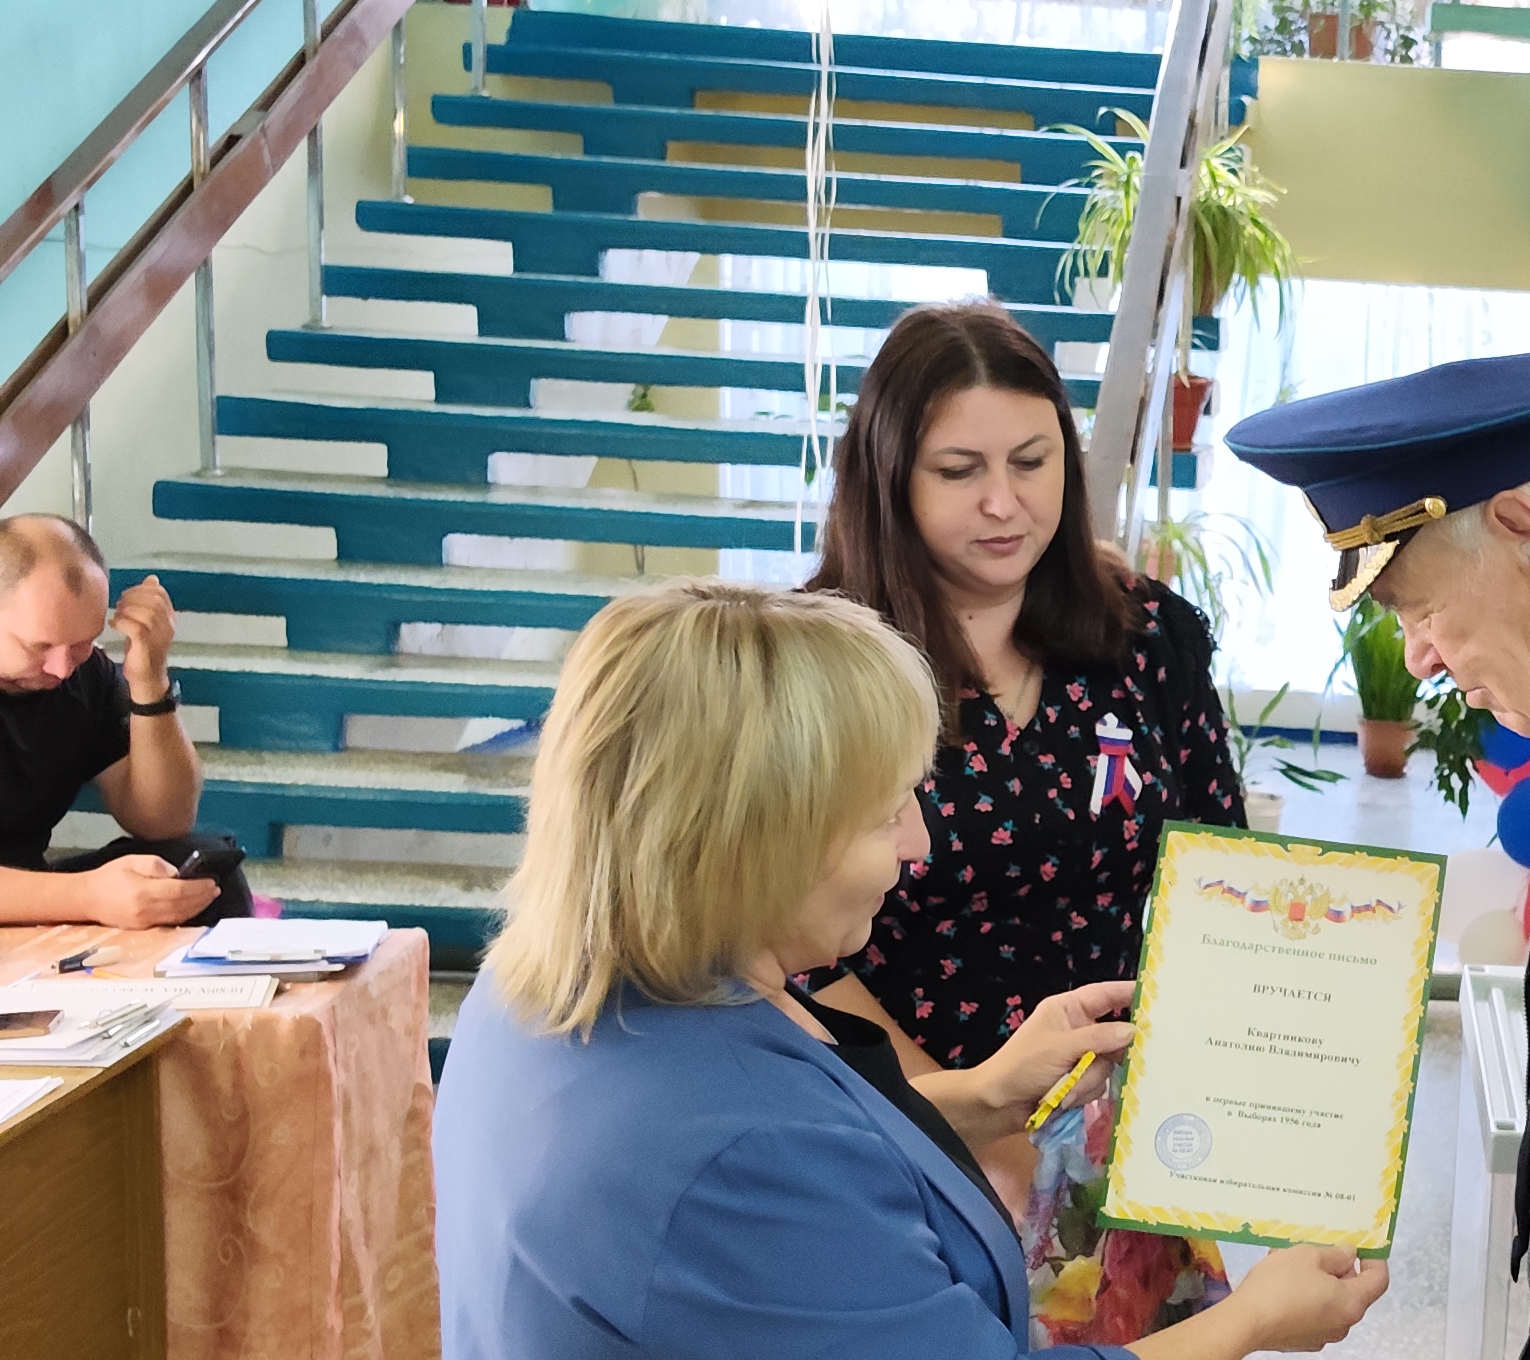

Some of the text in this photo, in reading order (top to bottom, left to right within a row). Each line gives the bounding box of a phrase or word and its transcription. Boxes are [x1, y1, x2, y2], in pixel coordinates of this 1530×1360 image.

[1201, 933, 1377, 966] Благодарственное письмо
[1252, 983, 1332, 1003] ВРУЧАЕТСЯ
[1205, 1036, 1362, 1067] Анатолию Владимировичу
[1280, 1116, 1299, 1126] 1956
